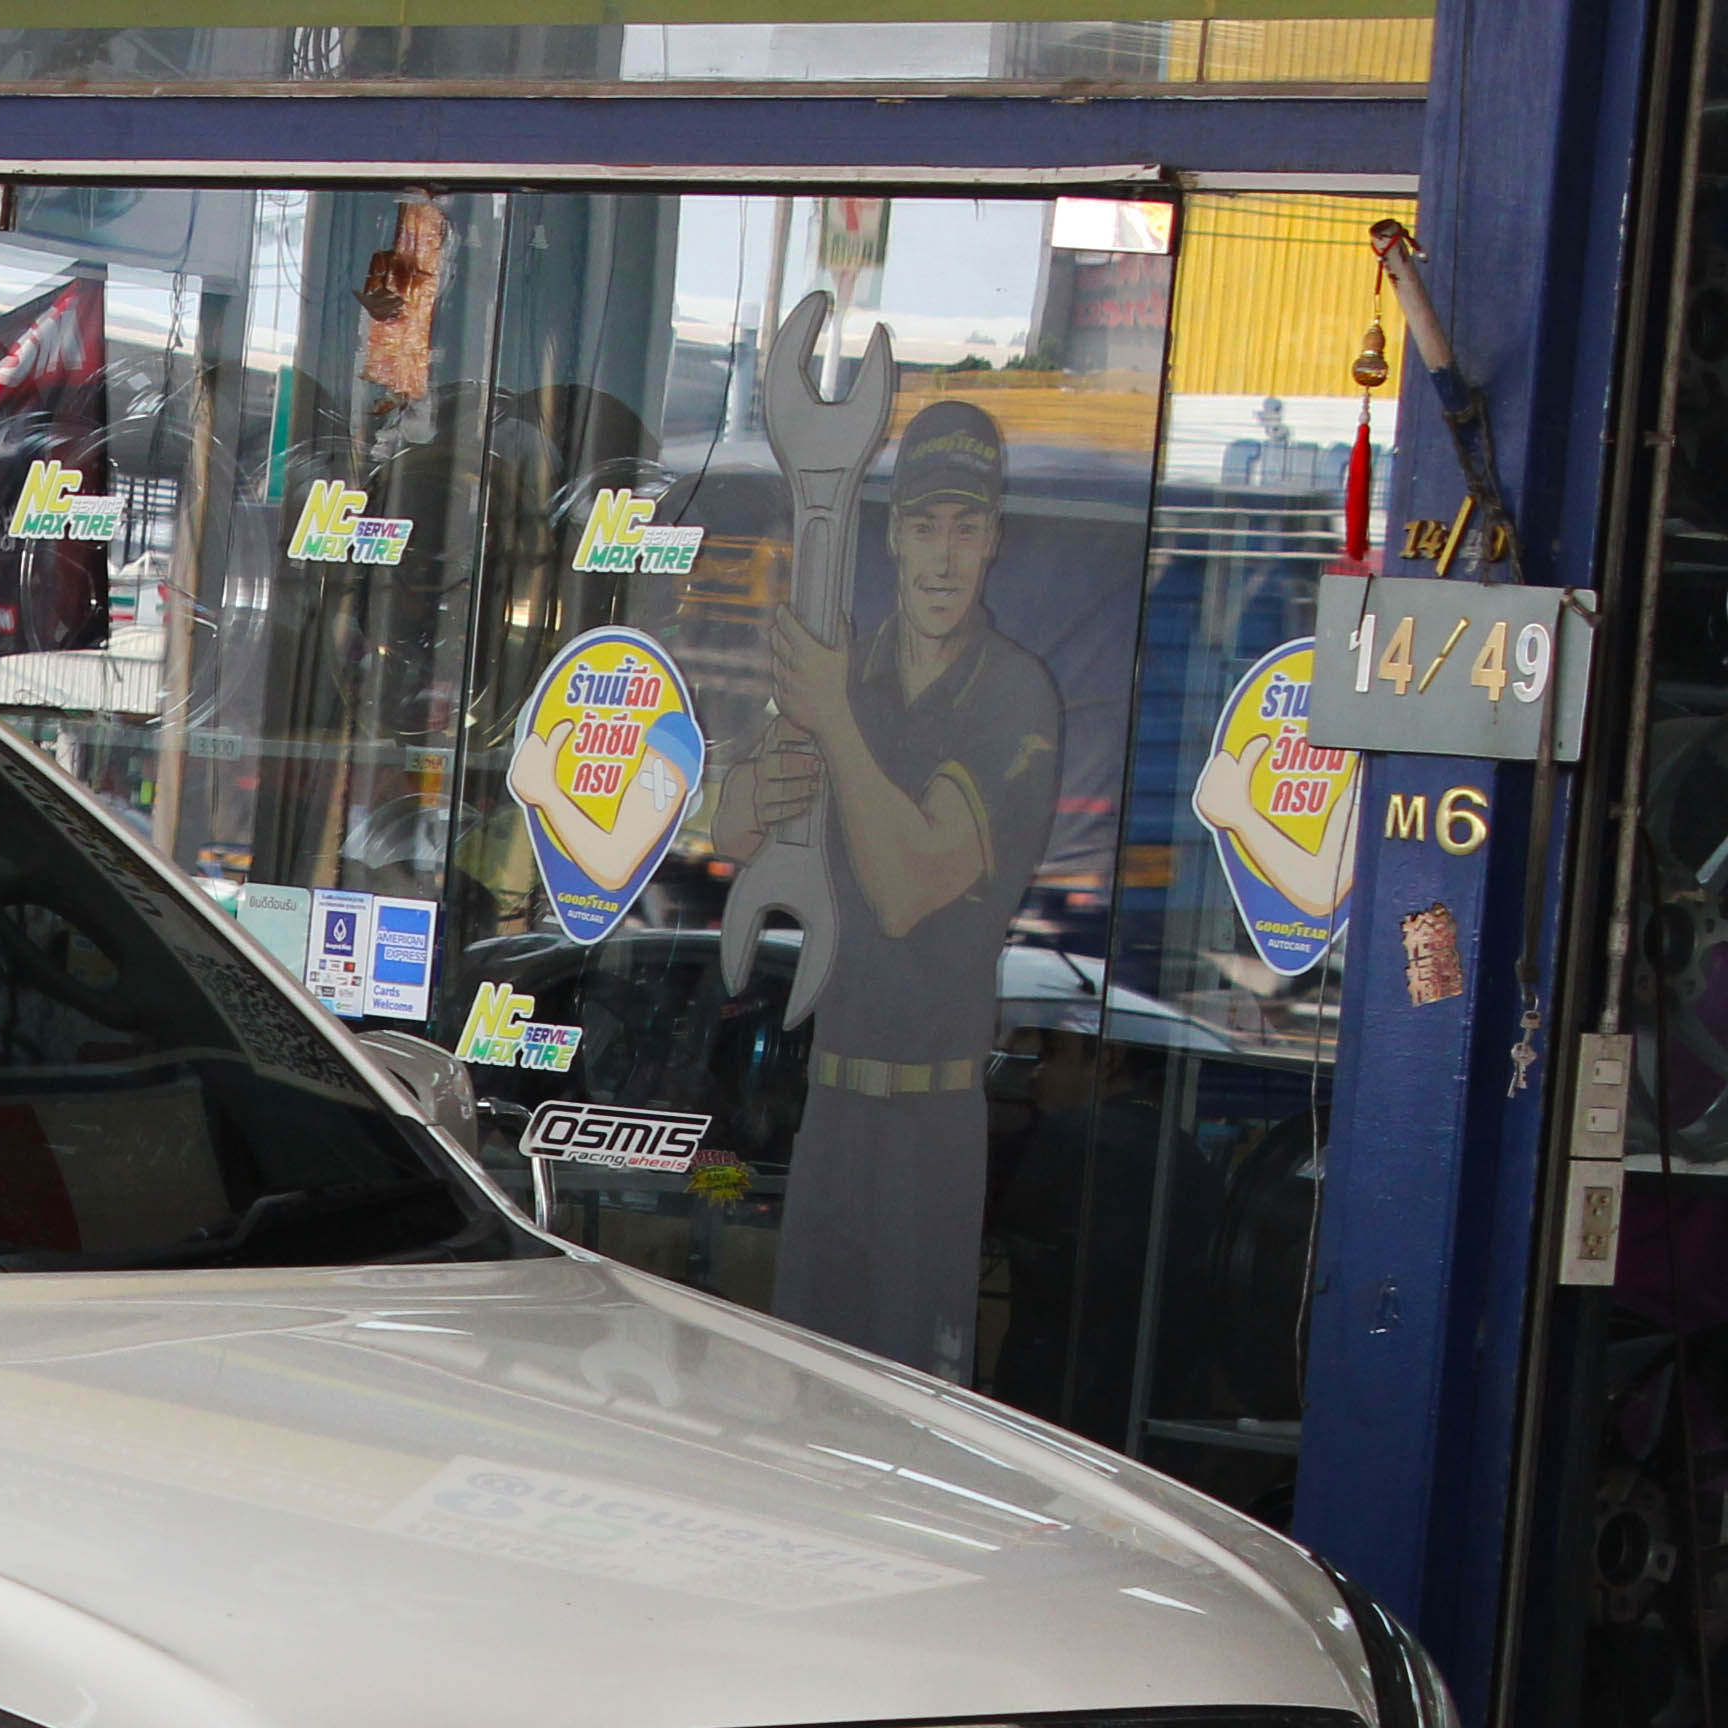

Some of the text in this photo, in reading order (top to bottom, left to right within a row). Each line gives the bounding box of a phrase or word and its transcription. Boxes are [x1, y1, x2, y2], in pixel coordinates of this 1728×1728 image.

[11, 463, 81, 534] NC
[21, 514, 118, 536] MAX TIRE
[291, 483, 412, 555] NC SERVICE
[576, 492, 654, 567] NC
[301, 535, 405, 561] MAX TIRE
[587, 545, 695, 569] MAX TIRE
[1348, 614, 1552, 704] 14/49
[572, 763, 623, 794] ครบ
[1270, 780, 1329, 813] ครบ
[376, 933, 425, 948] AMERICAN
[385, 949, 428, 962] EXPRESS
[373, 984, 400, 998] Cards
[372, 999, 413, 1012] Welcome
[456, 984, 578, 1057] NC SERVICE
[468, 1037, 576, 1069] MAX TIRE
[567, 1150, 687, 1172] racing wheels
